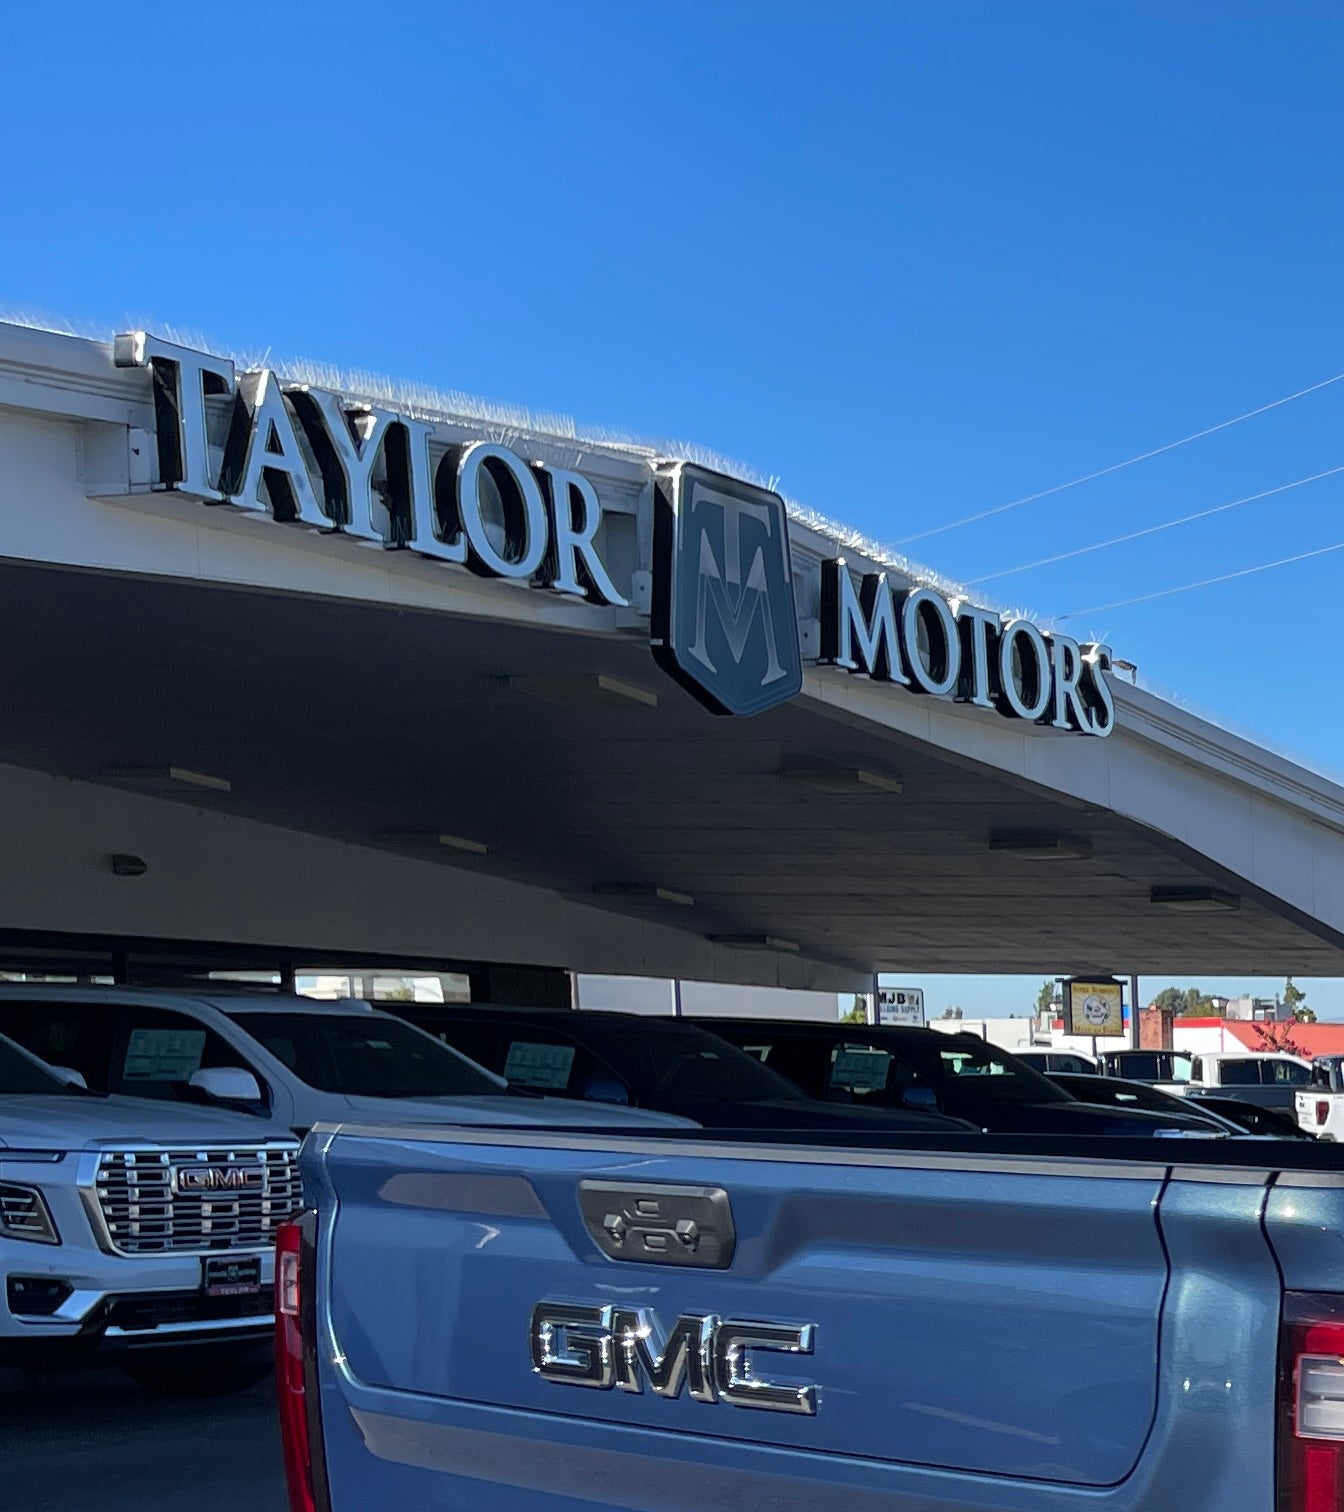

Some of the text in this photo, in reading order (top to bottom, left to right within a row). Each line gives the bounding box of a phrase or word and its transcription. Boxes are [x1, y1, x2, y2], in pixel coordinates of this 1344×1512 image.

[115, 332, 629, 607] TAYLOR
[832, 557, 1115, 738] MOTORS
[179, 1167, 264, 1190] GMC
[530, 1298, 820, 1416] GMC
